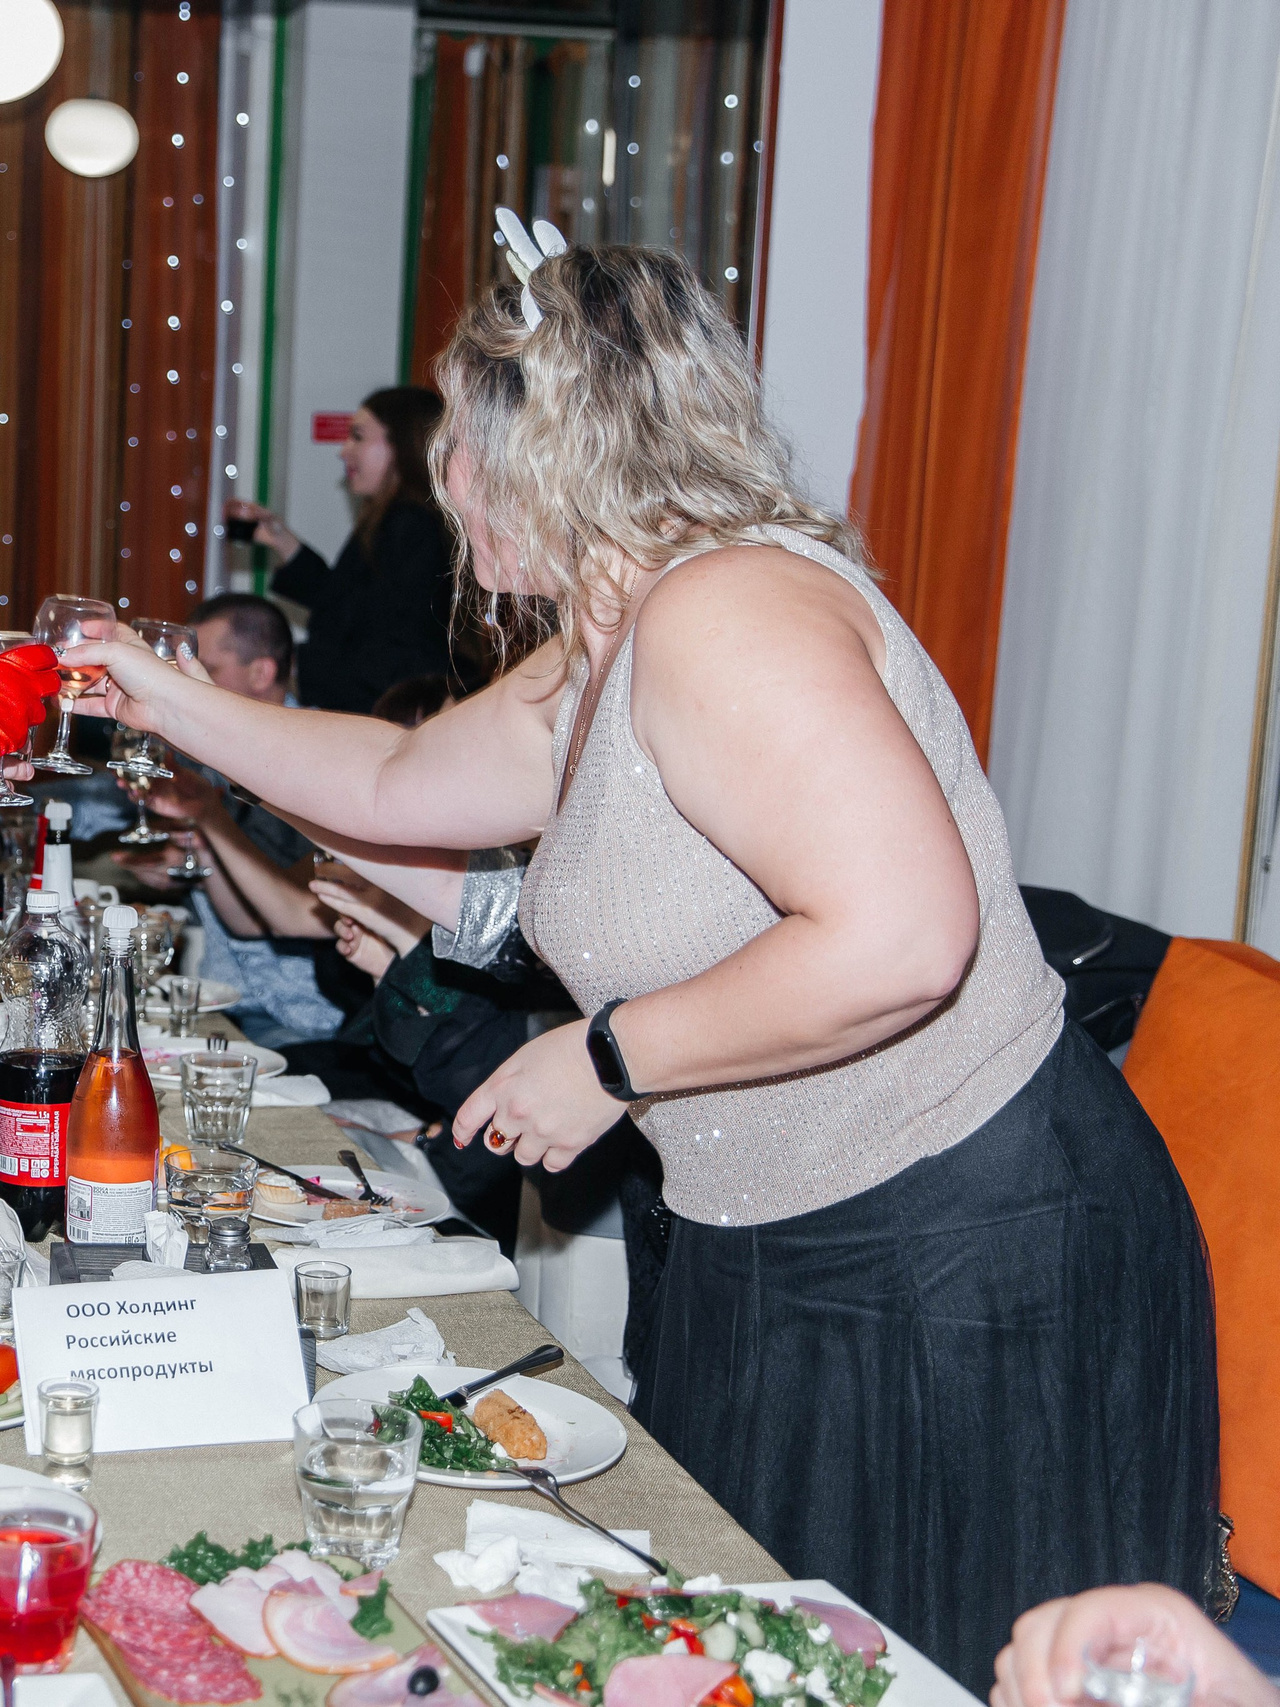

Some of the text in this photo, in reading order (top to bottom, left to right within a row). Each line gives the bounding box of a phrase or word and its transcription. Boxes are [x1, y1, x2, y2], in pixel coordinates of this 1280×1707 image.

[66, 1299, 197, 1318] ООО Холдинг
[66, 1329, 177, 1349] Российские
[70, 1360, 214, 1381] мясопродукты
